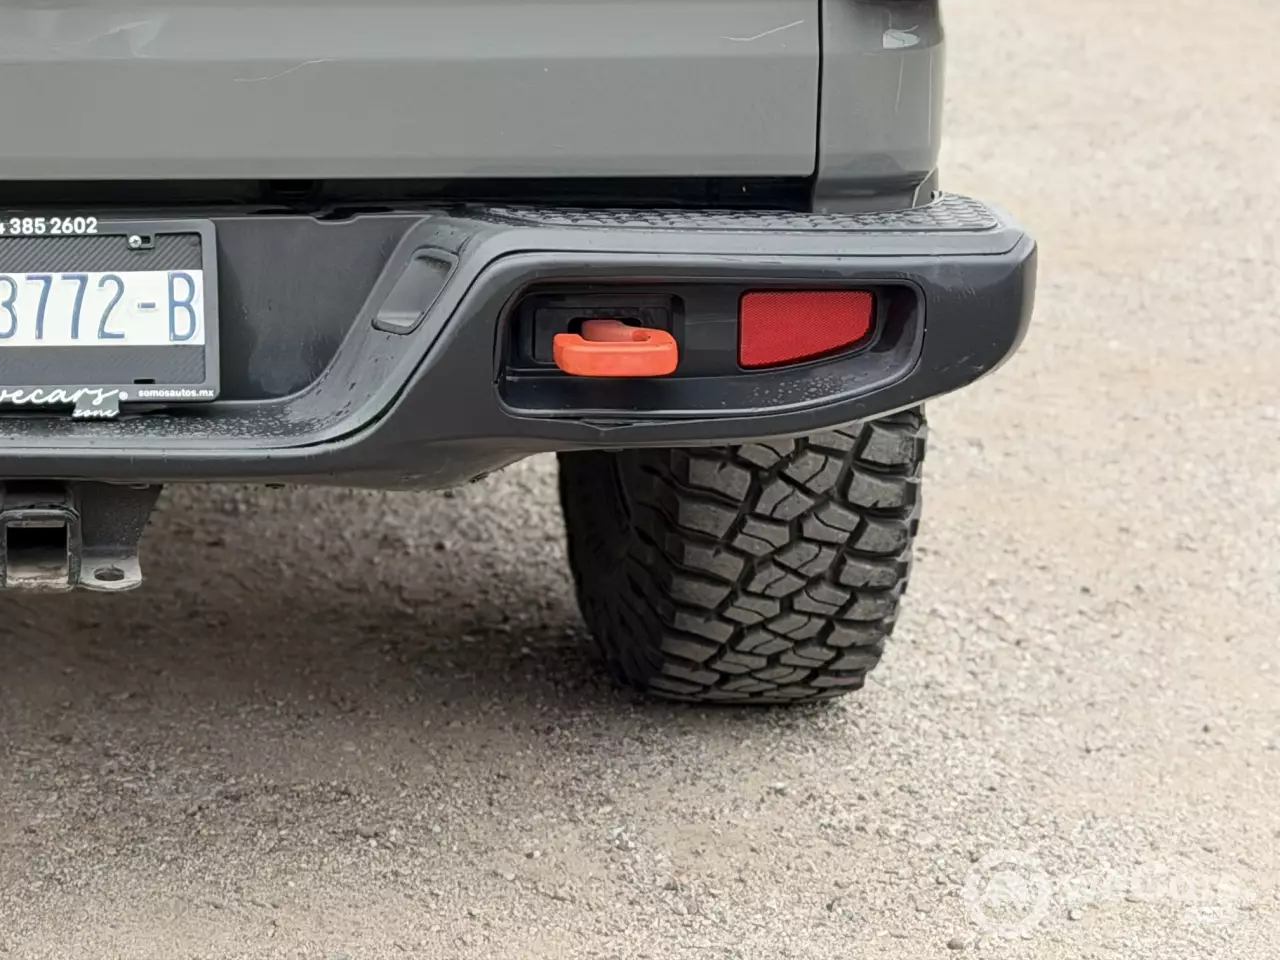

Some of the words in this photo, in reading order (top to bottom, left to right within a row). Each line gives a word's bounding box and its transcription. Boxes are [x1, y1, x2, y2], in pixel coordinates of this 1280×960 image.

[9, 217, 46, 234] 385
[49, 216, 98, 234] 2602
[138, 388, 214, 398] somosautos.mx
[72, 408, 119, 418] zone
